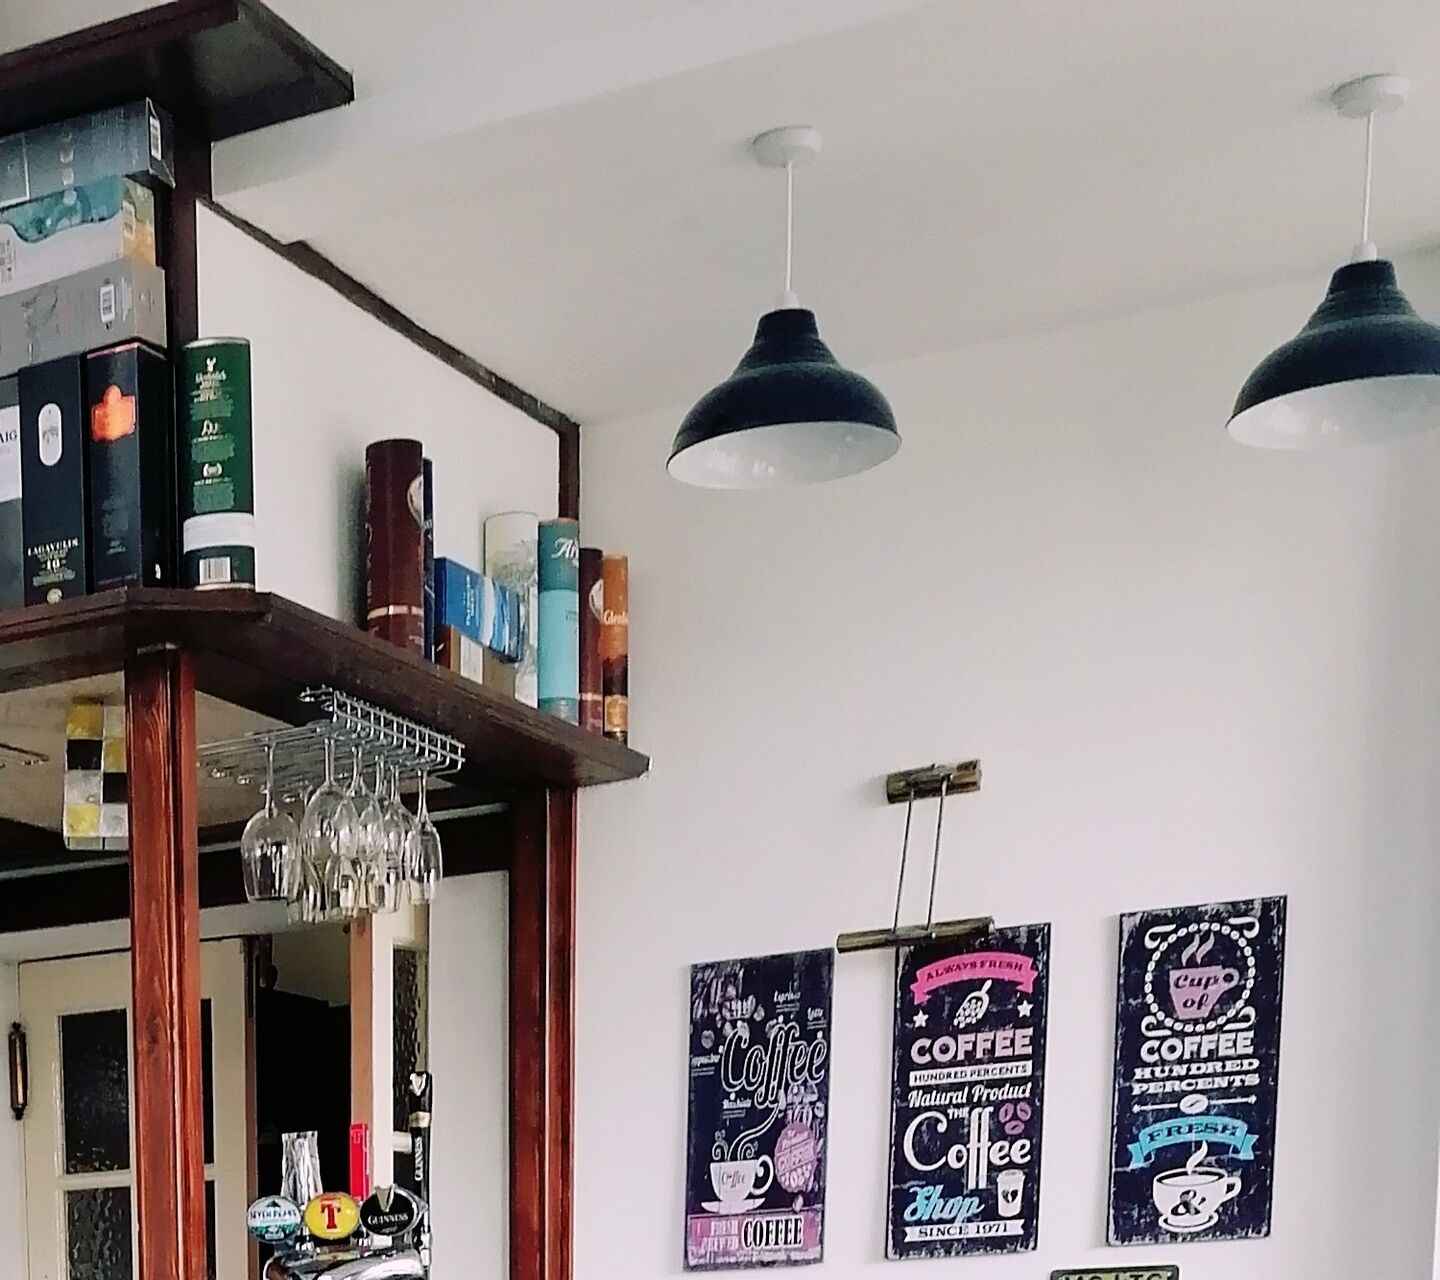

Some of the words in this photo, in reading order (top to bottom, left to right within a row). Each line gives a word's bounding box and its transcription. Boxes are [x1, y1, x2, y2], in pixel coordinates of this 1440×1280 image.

[925, 959, 978, 981] ALWAYS
[980, 959, 1023, 972] FRESH
[1173, 972, 1221, 995] Cup
[1182, 991, 1209, 1011] of
[909, 1026, 1035, 1065] COFFEE
[1140, 1030, 1255, 1064] COFFEE
[720, 1021, 828, 1110] Coffee
[913, 1069, 968, 1084] HUNDRED
[969, 1063, 1028, 1079] PERCENTS
[1133, 1057, 1260, 1081] HUNDRED
[907, 1085, 969, 1109] Natural
[971, 1081, 1033, 1103] Product
[1131, 1072, 1261, 1097] PERCENTS
[1147, 1122, 1240, 1145] FRESH
[902, 1106, 1032, 1190] Coffee
[903, 1184, 985, 1225] Shop
[367, 1212, 409, 1226] GUINNESS
[917, 1225, 969, 1239] SINCE
[974, 1222, 1008, 1236] 1971
[742, 1216, 803, 1249] COFFEE
